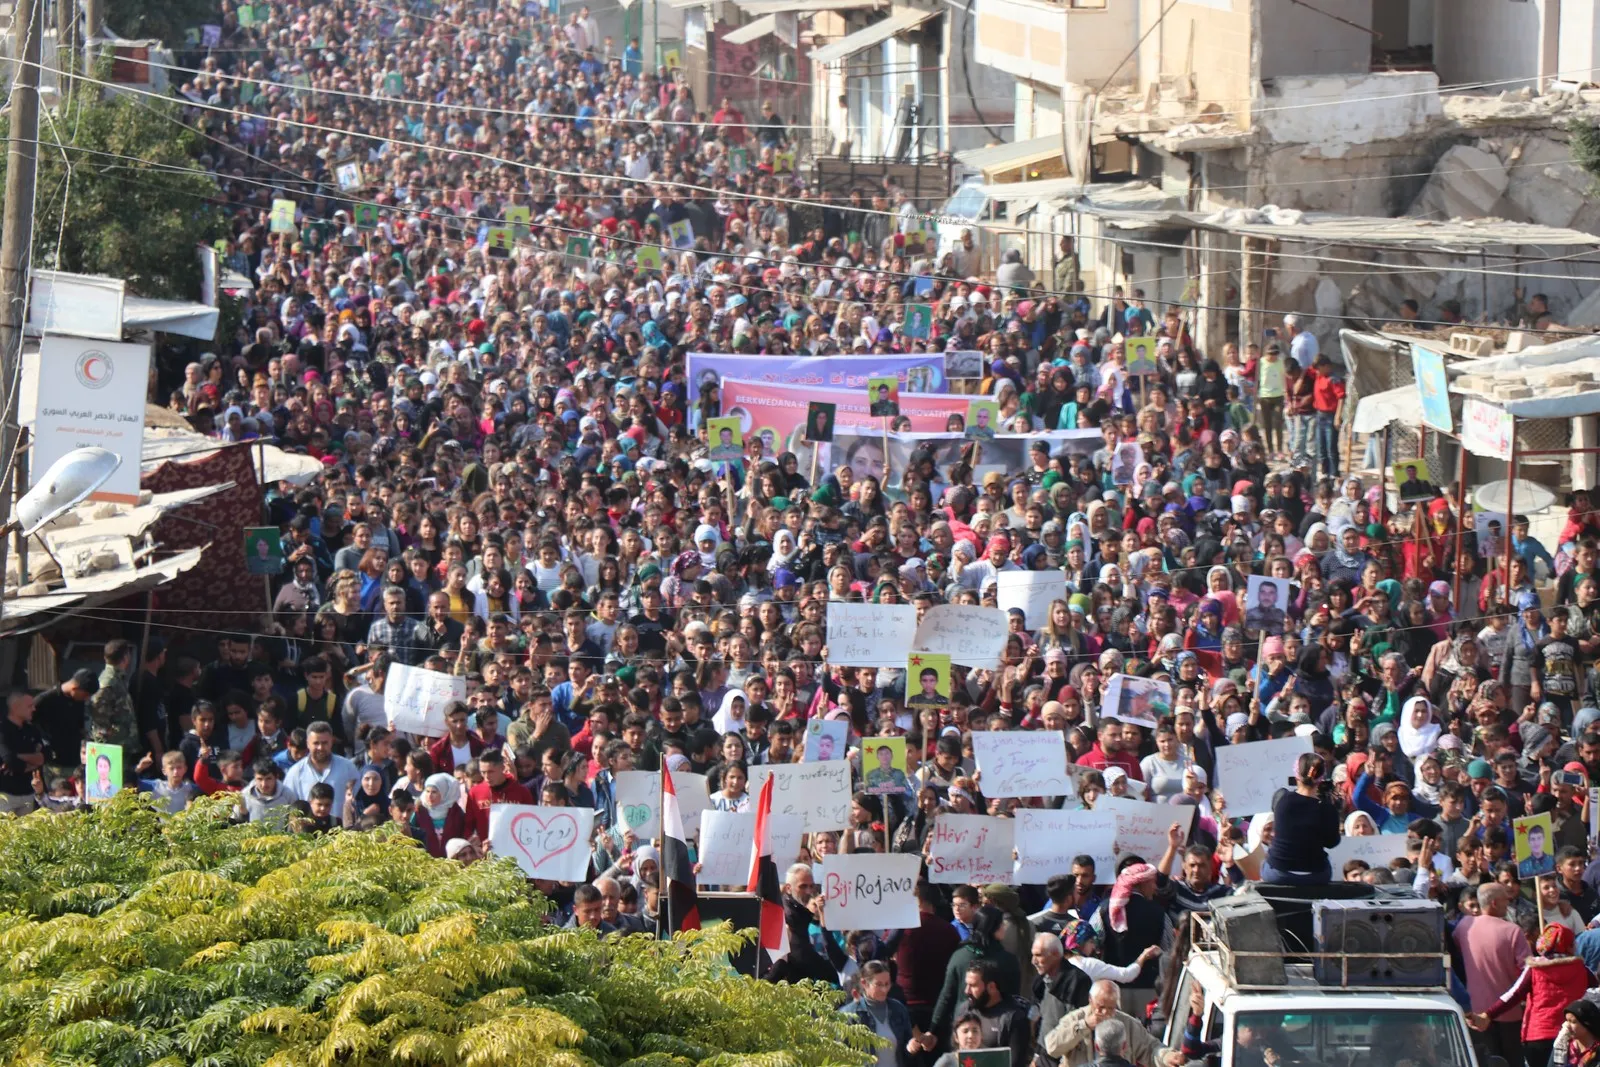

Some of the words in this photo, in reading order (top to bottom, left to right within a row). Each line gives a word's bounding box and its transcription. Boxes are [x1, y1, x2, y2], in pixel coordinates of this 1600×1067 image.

[42, 407, 68, 417] السوري
[69, 410, 93, 419] العربي
[94, 411, 116, 421] الأحمر
[116, 414, 139, 423] الهلال
[844, 643, 871, 658] Afrin
[855, 873, 913, 906] Rojava
